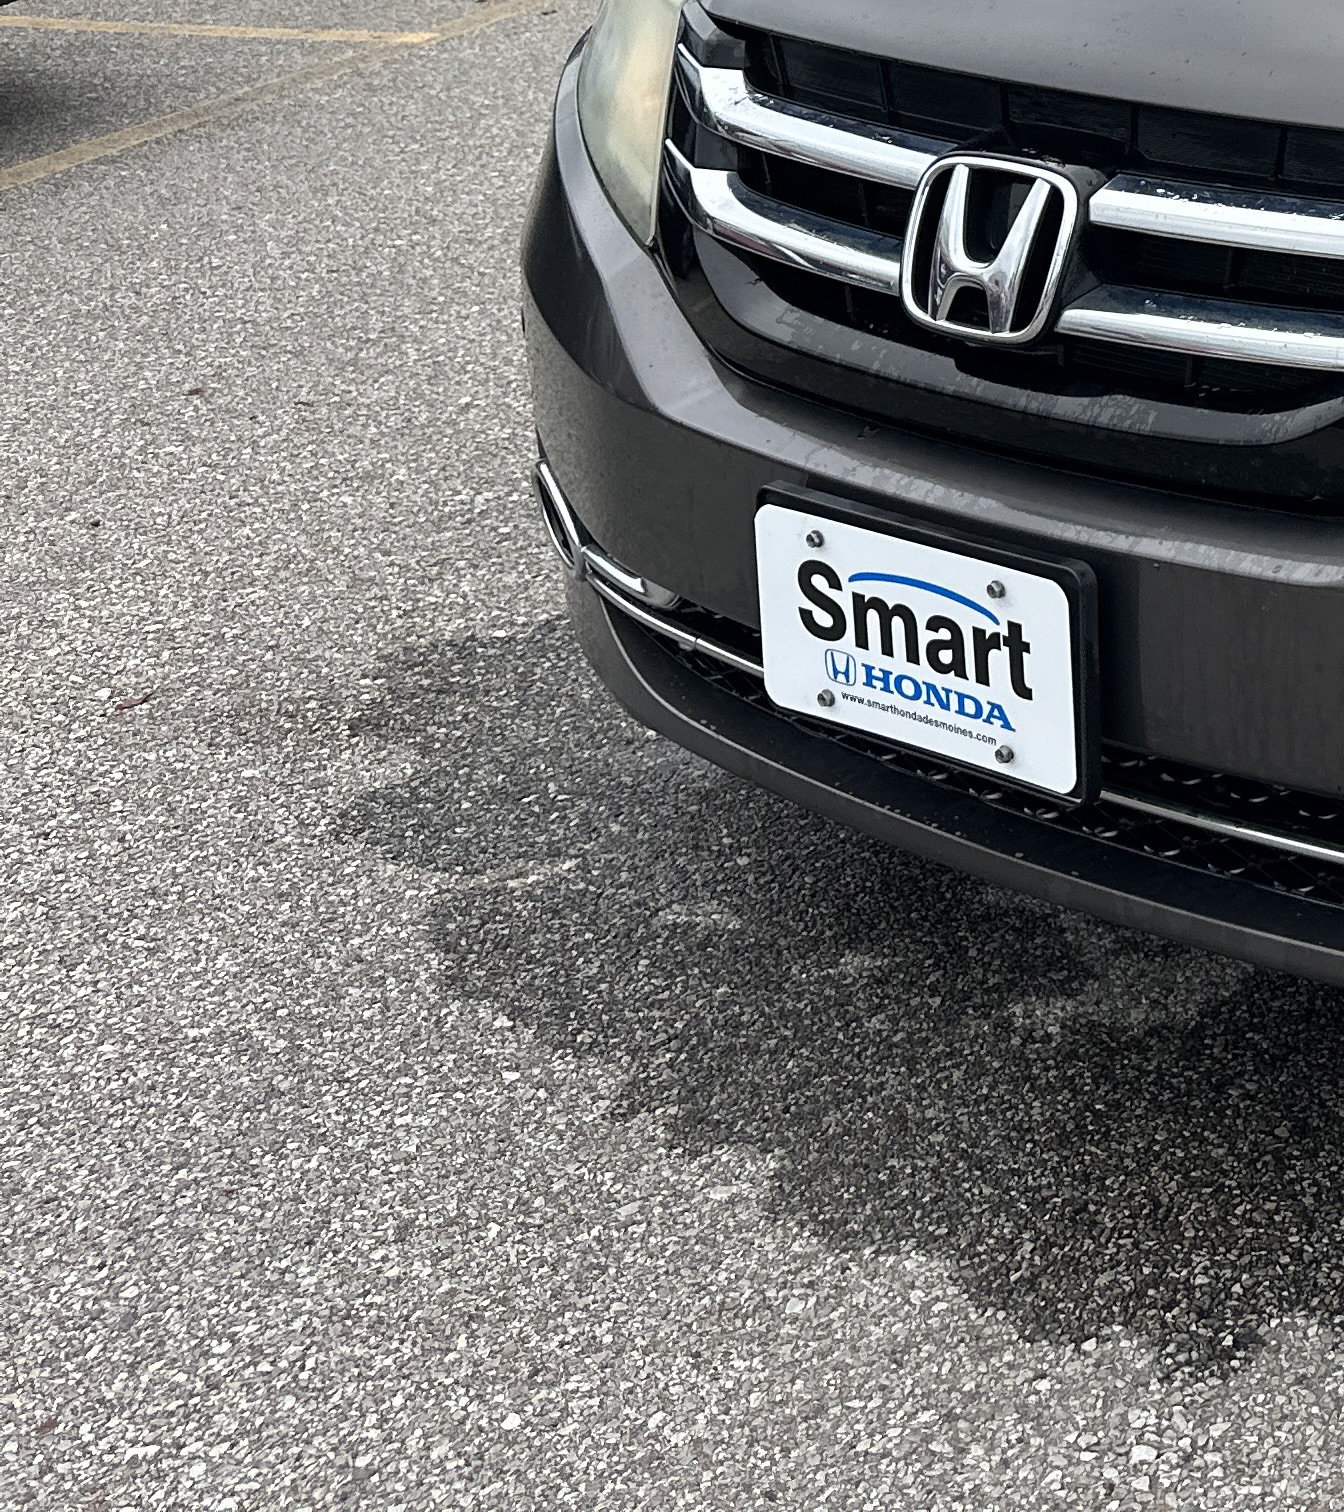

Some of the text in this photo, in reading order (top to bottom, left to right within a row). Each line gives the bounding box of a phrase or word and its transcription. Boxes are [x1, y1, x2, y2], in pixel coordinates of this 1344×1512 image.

[797, 559, 1033, 701] Smart
[841, 691, 997, 747] www.smarthondadesmoines.com
[861, 663, 1016, 733] HONDA
